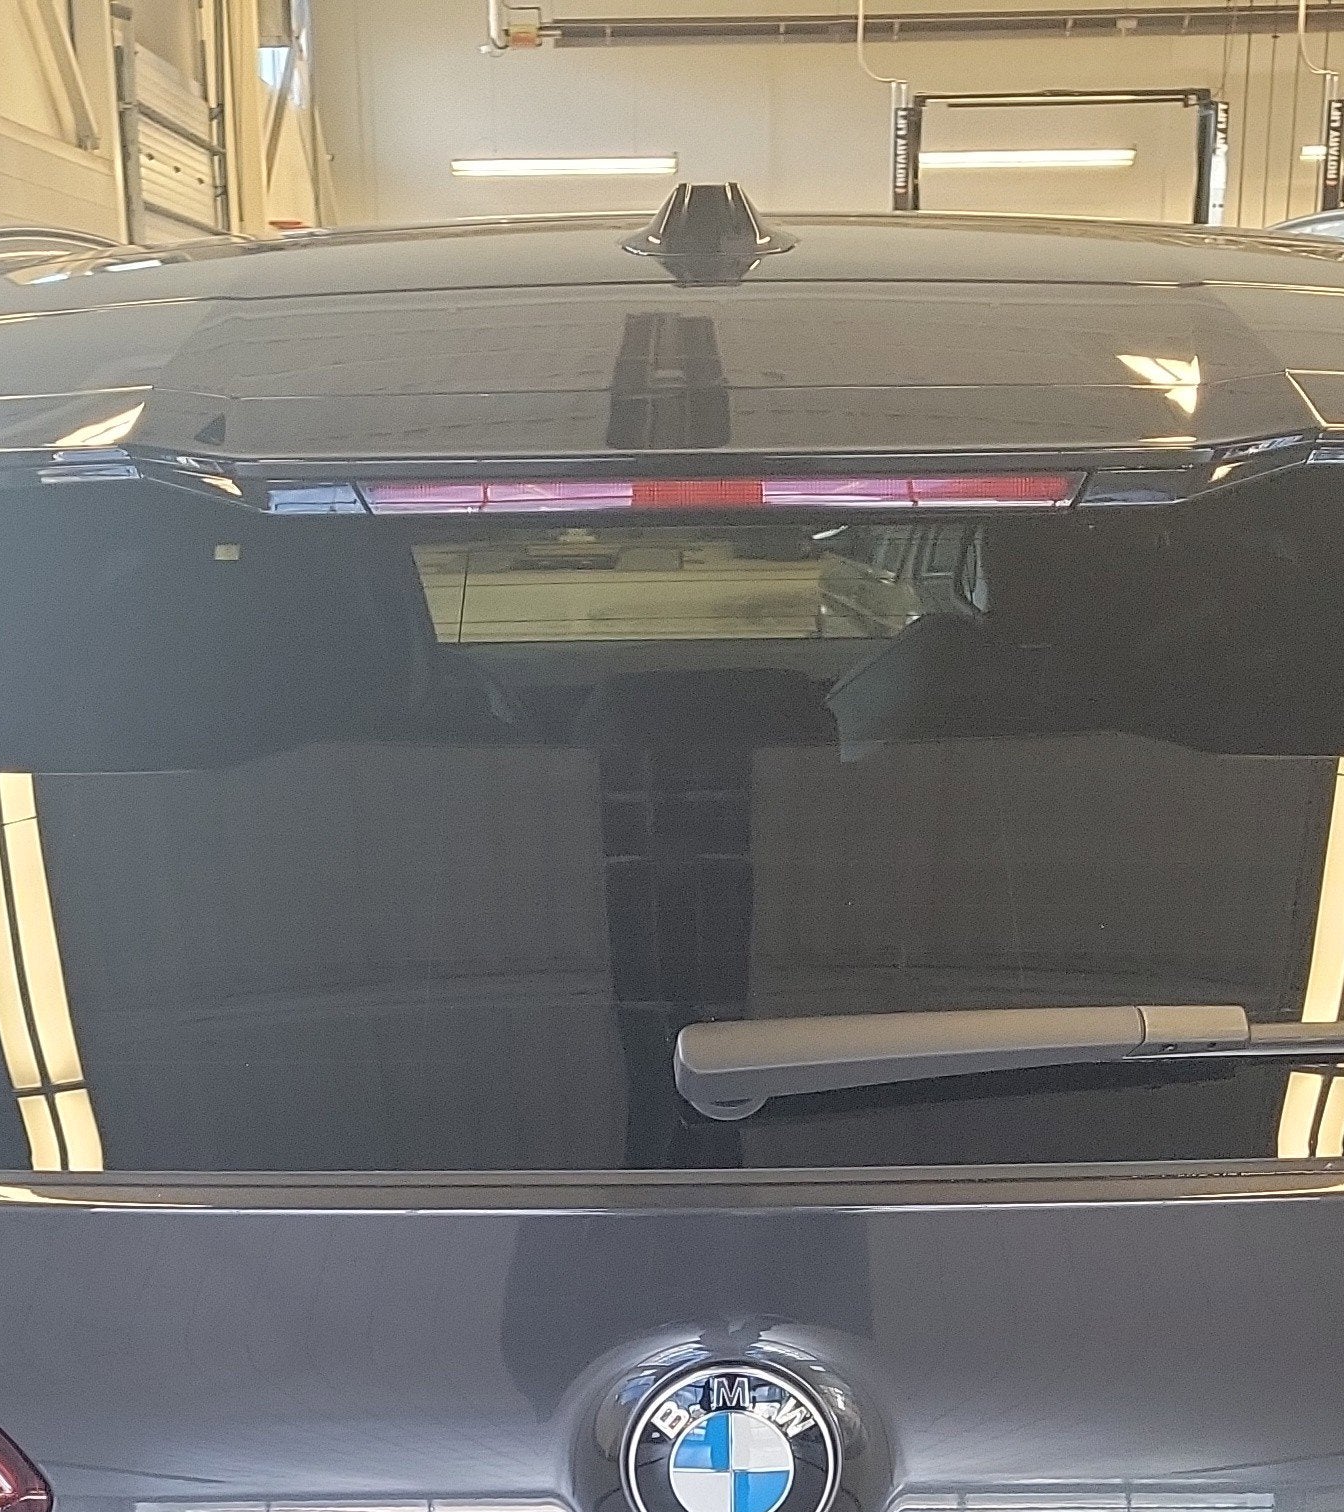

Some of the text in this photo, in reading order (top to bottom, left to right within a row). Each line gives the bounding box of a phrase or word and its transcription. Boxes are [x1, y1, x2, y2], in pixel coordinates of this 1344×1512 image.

[895, 110, 908, 187] ROTARY LIFT
[1216, 102, 1229, 129] LIFT
[1327, 101, 1343, 179] ROTARY LIFT
[650, 1376, 816, 1441] BMW
